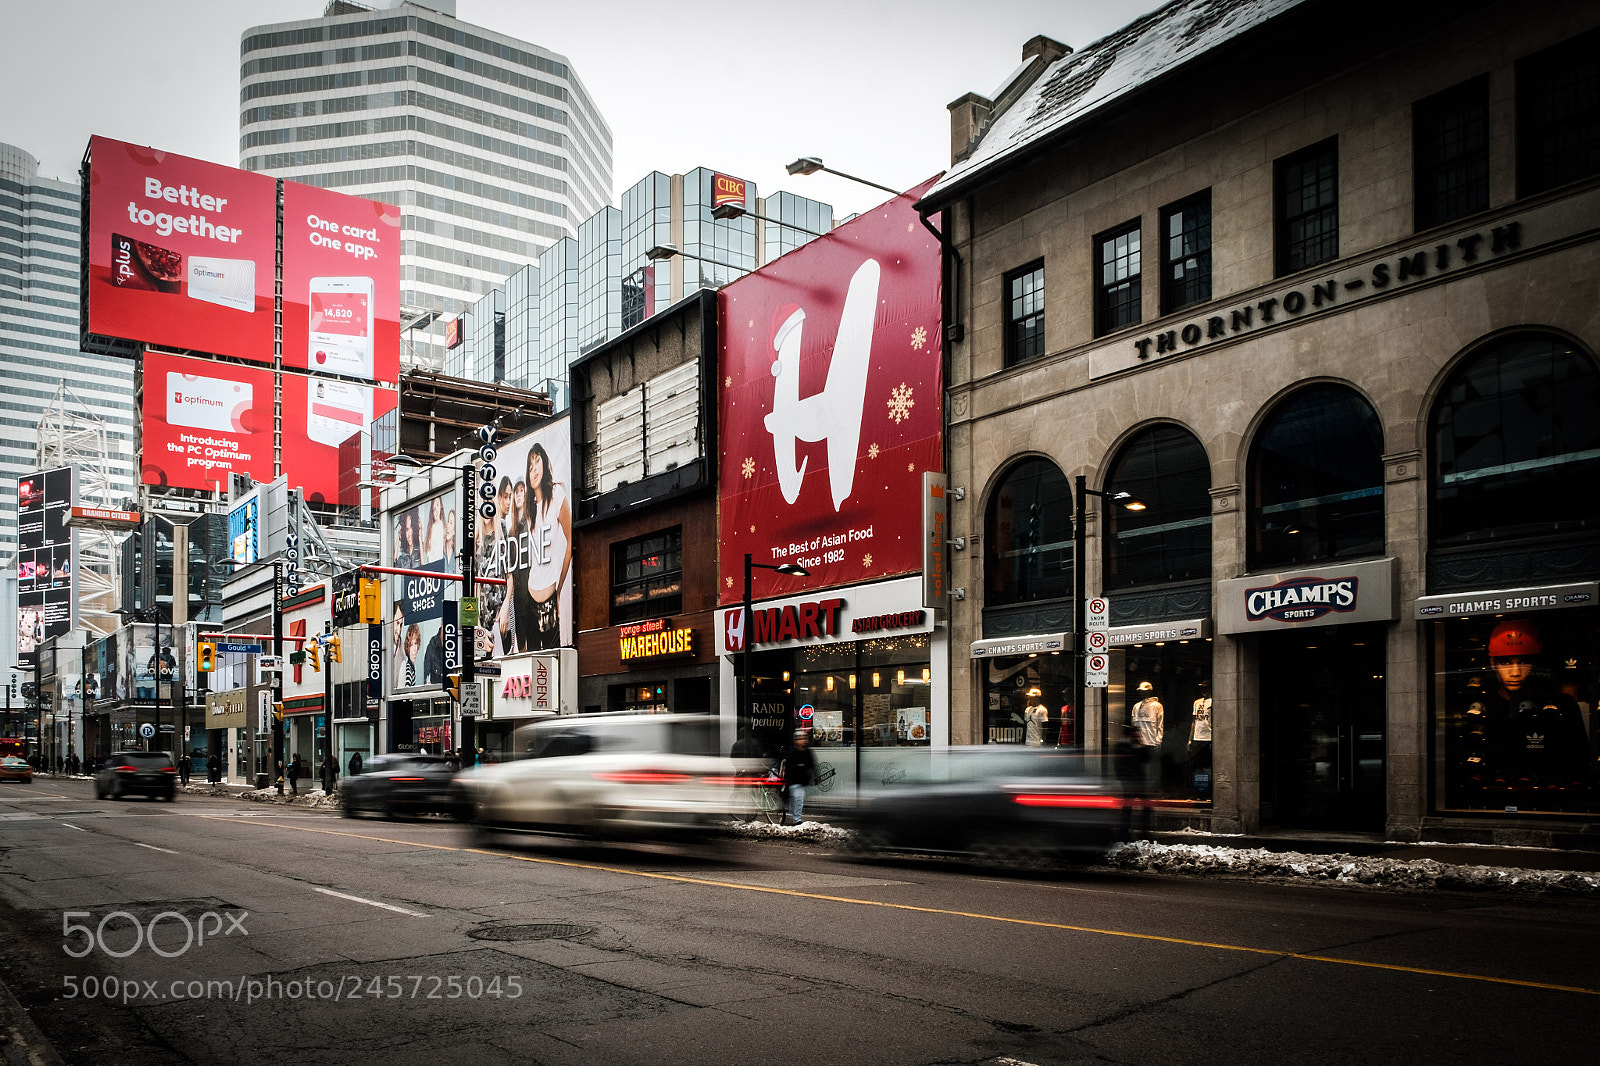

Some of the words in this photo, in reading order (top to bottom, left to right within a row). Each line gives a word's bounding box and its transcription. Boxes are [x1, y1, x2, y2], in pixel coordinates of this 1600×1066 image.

[144, 176, 228, 214] Better
[717, 177, 744, 196] CIBC
[127, 201, 243, 244] together
[306, 214, 338, 233] One
[341, 222, 381, 243] card.
[309, 231, 341, 252] One
[344, 240, 378, 260] app.
[193, 268, 225, 280] Optimum
[1134, 222, 1522, 360] THORNTON-SMITH
[324, 308, 353, 319] 14,520
[764, 258, 881, 512] H
[184, 395, 224, 408] optimum
[180, 433, 239, 449] Introducing
[167, 442, 185, 454] the
[187, 444, 202, 455] PC
[204, 446, 252, 462] Optimum
[187, 456, 232, 470] program
[467, 469, 475, 538] DOWNTOWN
[82, 508, 110, 518] BRANDED
[111, 511, 131, 520] CITIES
[932, 511, 944, 547] king
[485, 523, 552, 579] ARDENE
[771, 546, 788, 559] The
[789, 541, 809, 556] Best
[810, 538, 821, 553] of
[821, 534, 848, 548] Asian
[849, 525, 873, 543] Food
[796, 555, 821, 569] Since
[822, 550, 845, 565] 1982
[932, 552, 942, 598] salad
[408, 576, 441, 600] GLOBO
[1564, 593, 1591, 602] CHAMPS
[412, 596, 435, 612] SHOES
[1247, 581, 1354, 617] CHAMPS
[1449, 600, 1501, 614] CHAMPS
[1505, 595, 1557, 610] SPORTS
[1284, 608, 1315, 619] SPORTS
[1420, 606, 1443, 614] CHAMPS
[620, 624, 641, 638] yonge
[642, 619, 665, 633] street
[753, 599, 842, 644] MART
[852, 617, 879, 632] ASIAN
[881, 611, 923, 629] GROCERY
[444, 622, 455, 669] GLOBO
[620, 627, 692, 660] WAREHOUSE
[1109, 632, 1142, 643] CHAMPS
[1144, 628, 1177, 640] SPORTS
[227, 644, 247, 653] Gould
[988, 646, 1016, 654] CHAMPS
[1017, 642, 1044, 652] SPORTS
[370, 640, 380, 680] GLOBO
[536, 660, 548, 707] ARDENE
[752, 702, 785, 714] RAND
[752, 716, 785, 730] pening
